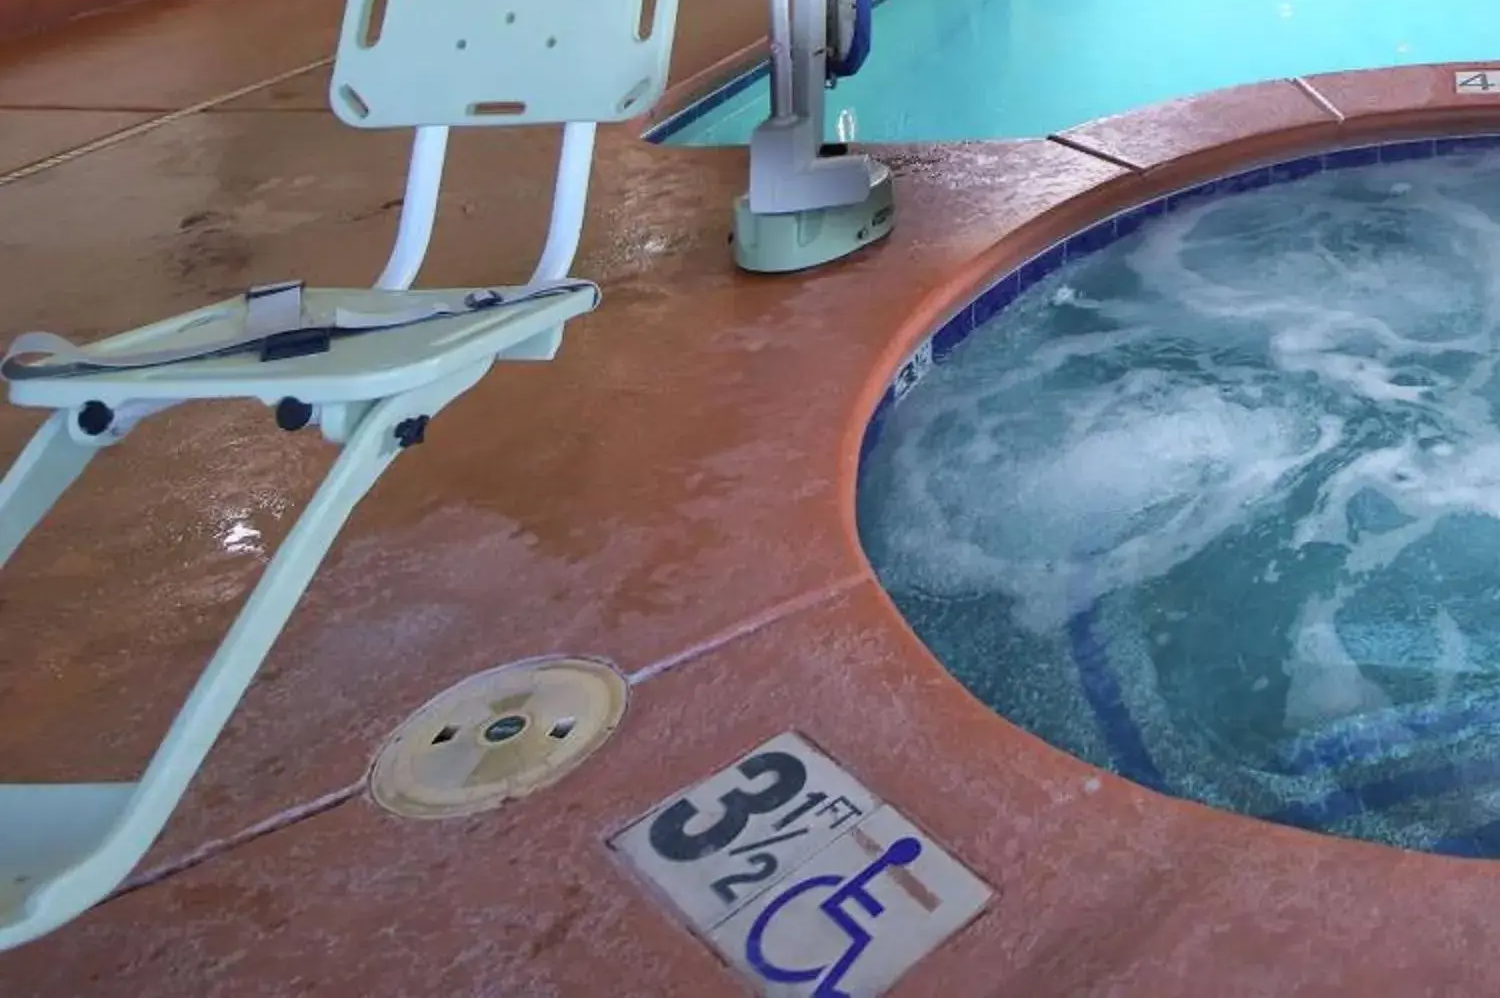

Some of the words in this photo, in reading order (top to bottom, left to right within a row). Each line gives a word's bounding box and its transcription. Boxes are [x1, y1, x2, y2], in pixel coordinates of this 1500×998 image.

[1459, 73, 1496, 91] 4
[648, 751, 807, 863] 3
[815, 795, 863, 830] FT
